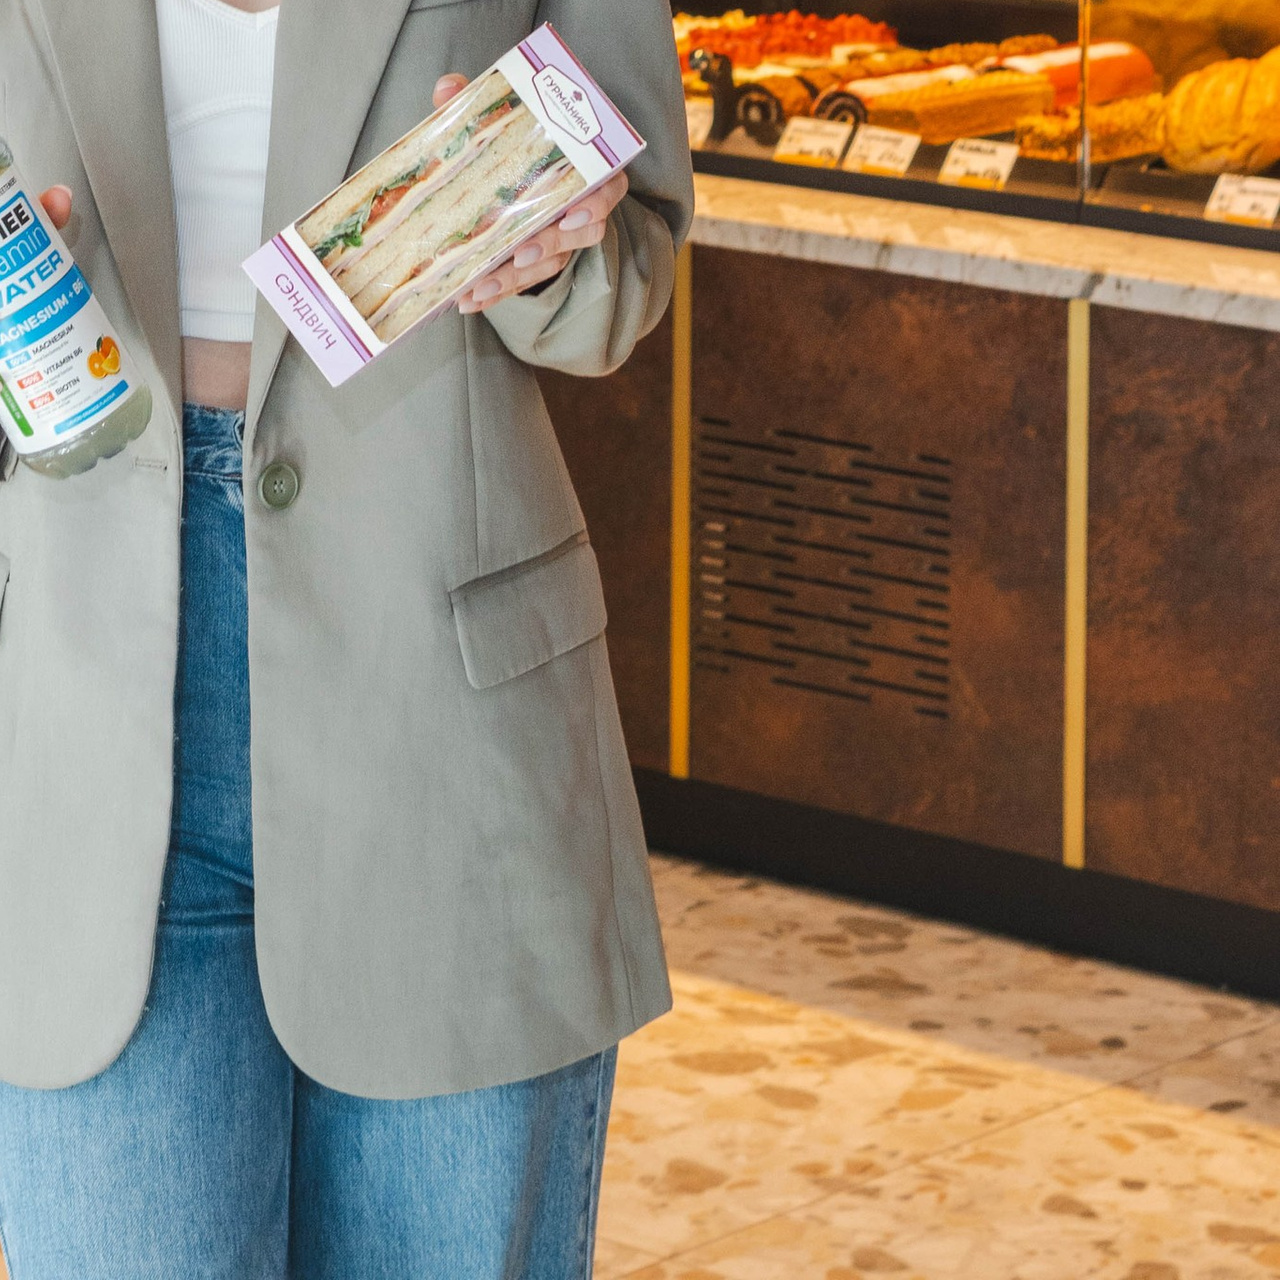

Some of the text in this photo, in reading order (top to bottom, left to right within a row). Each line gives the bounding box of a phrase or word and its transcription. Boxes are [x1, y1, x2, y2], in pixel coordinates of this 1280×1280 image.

[542, 74, 591, 136] ГУРМАНИКА
[73, 277, 85, 294] B6
[274, 272, 337, 350] СЭНДВИЧ
[31, 324, 76, 356] MAGNESIUM
[43, 354, 74, 376] VITAMIN
[72, 346, 84, 361] B6
[54, 376, 81, 396] BIOTIN
